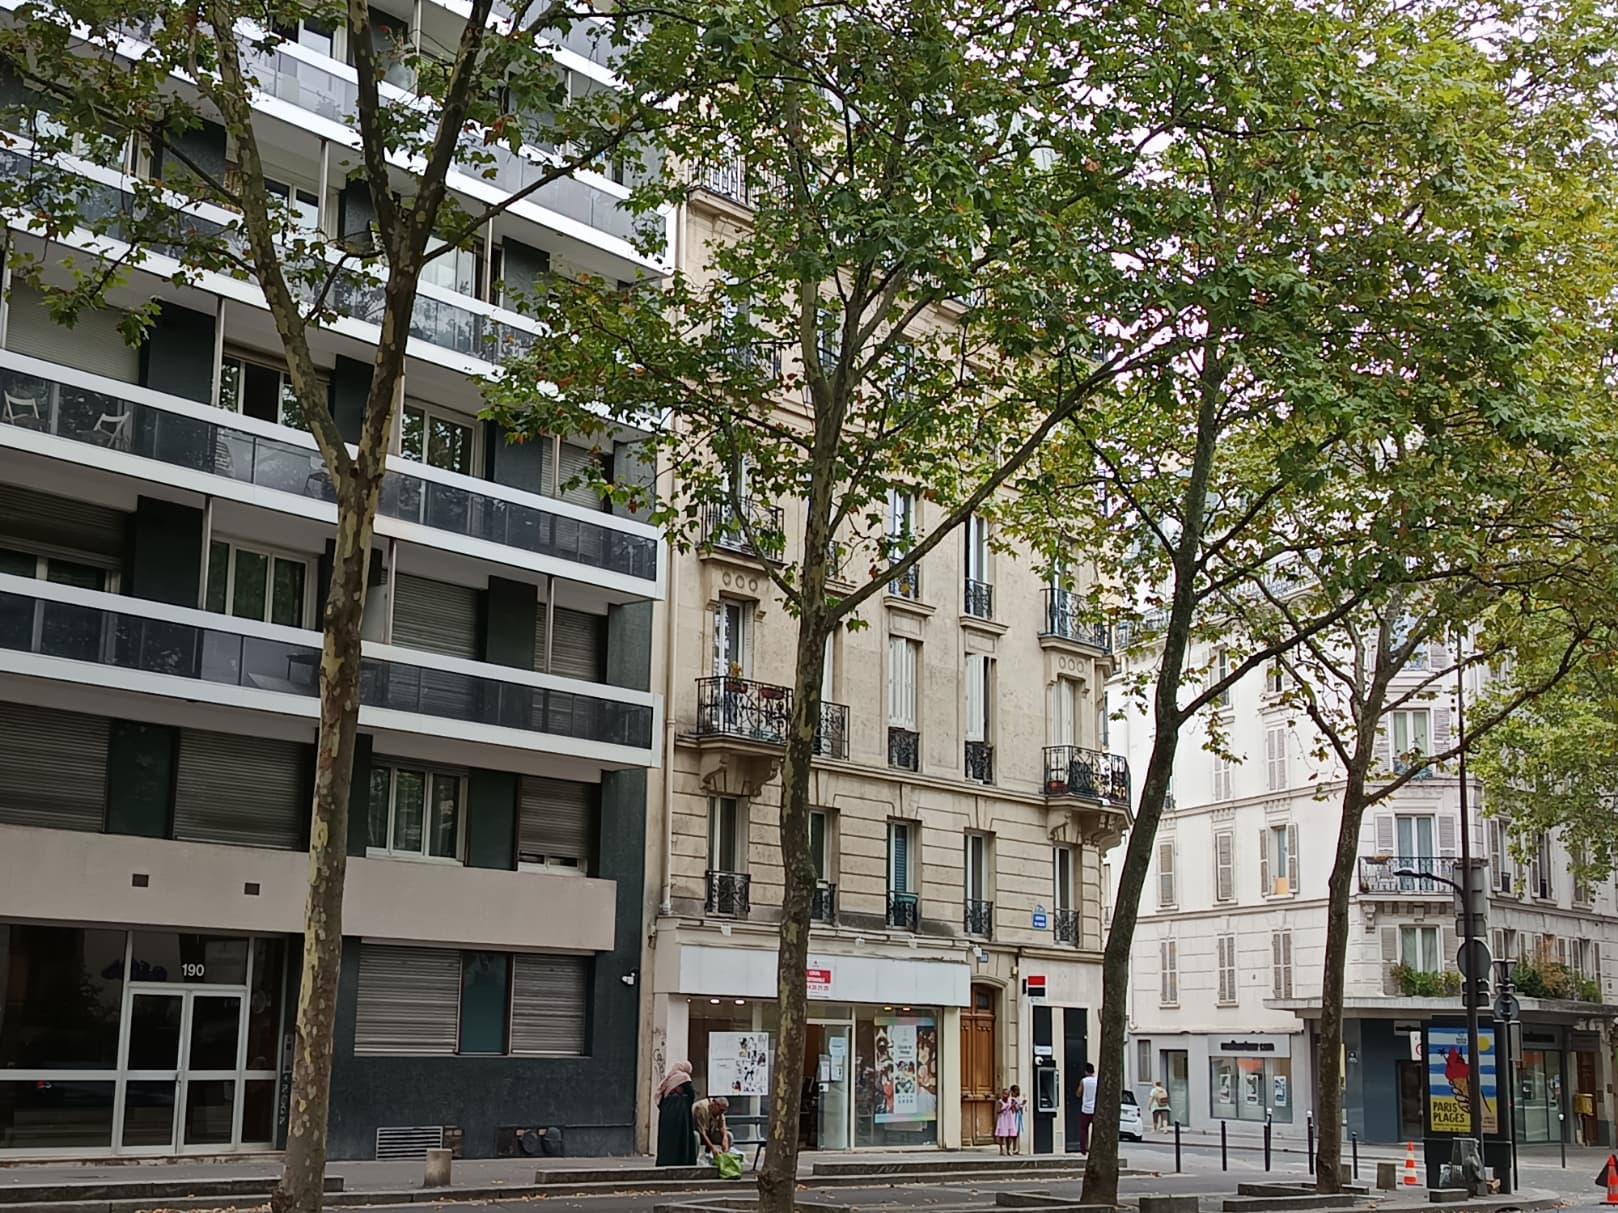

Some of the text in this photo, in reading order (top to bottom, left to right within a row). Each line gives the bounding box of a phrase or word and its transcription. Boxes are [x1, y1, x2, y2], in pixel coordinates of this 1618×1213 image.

[181, 963, 205, 977] 190
[1433, 1102, 1458, 1112] PARIS
[1433, 1112, 1465, 1123] PLAGES
